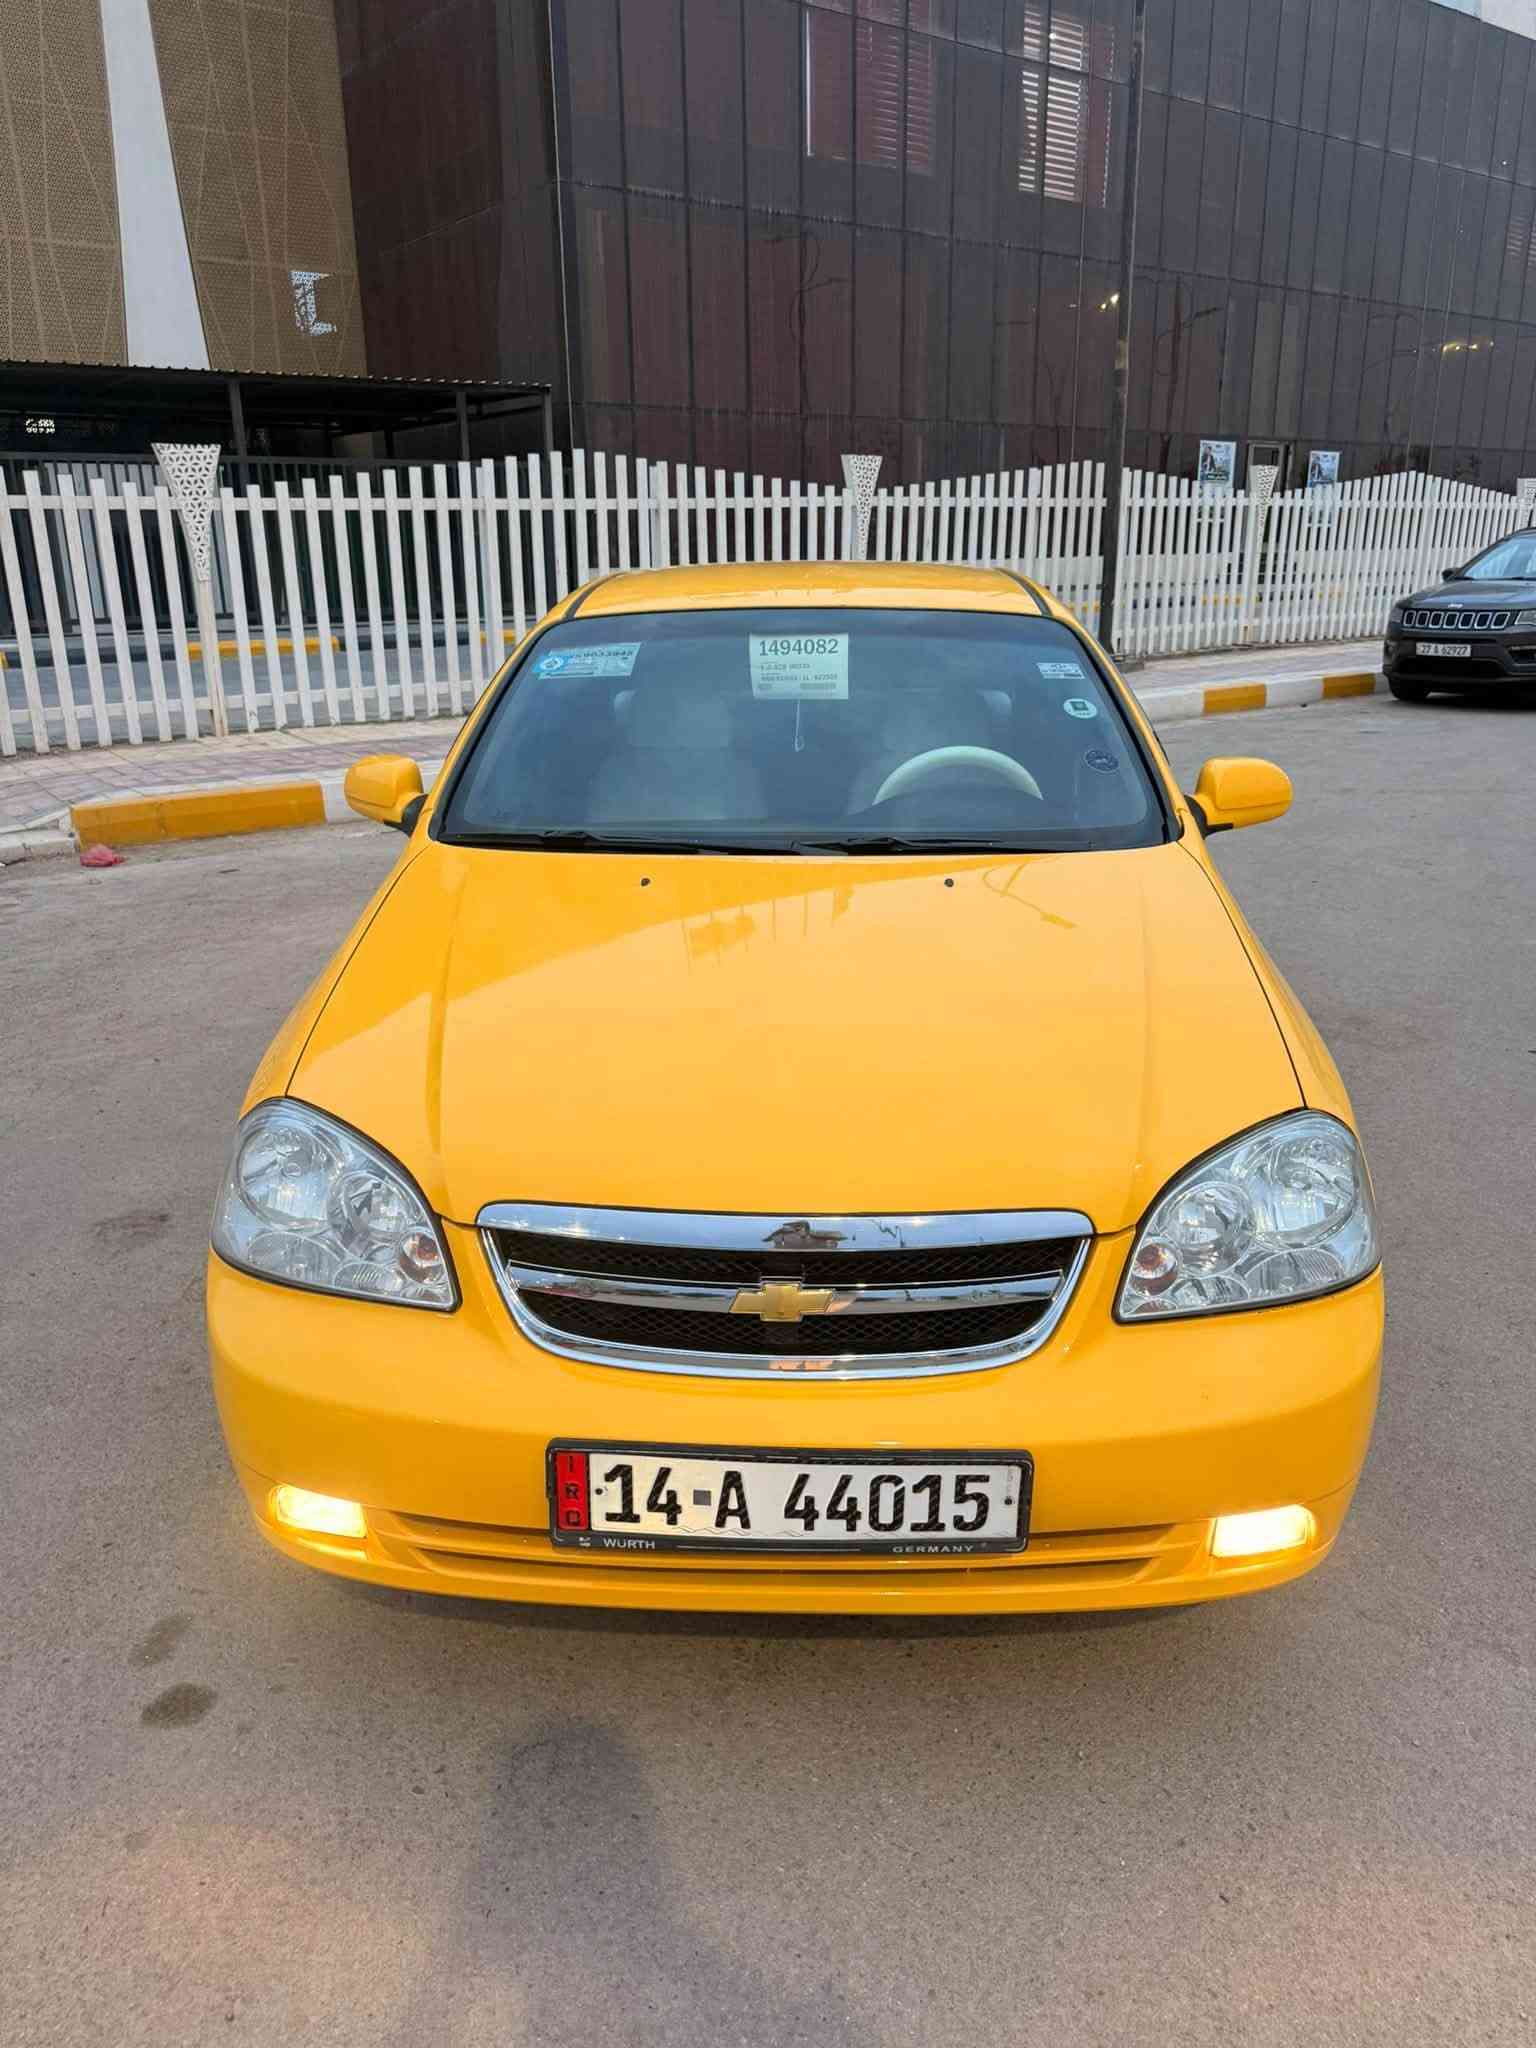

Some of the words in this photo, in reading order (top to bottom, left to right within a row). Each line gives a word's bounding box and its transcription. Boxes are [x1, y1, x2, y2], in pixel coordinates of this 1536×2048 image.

[759, 638, 839, 656] 1494082
[604, 1464, 682, 1525] 14
[715, 1470, 751, 1529] A
[784, 1473, 991, 1533] 44015
[892, 1544, 974, 1553] GERMANY
